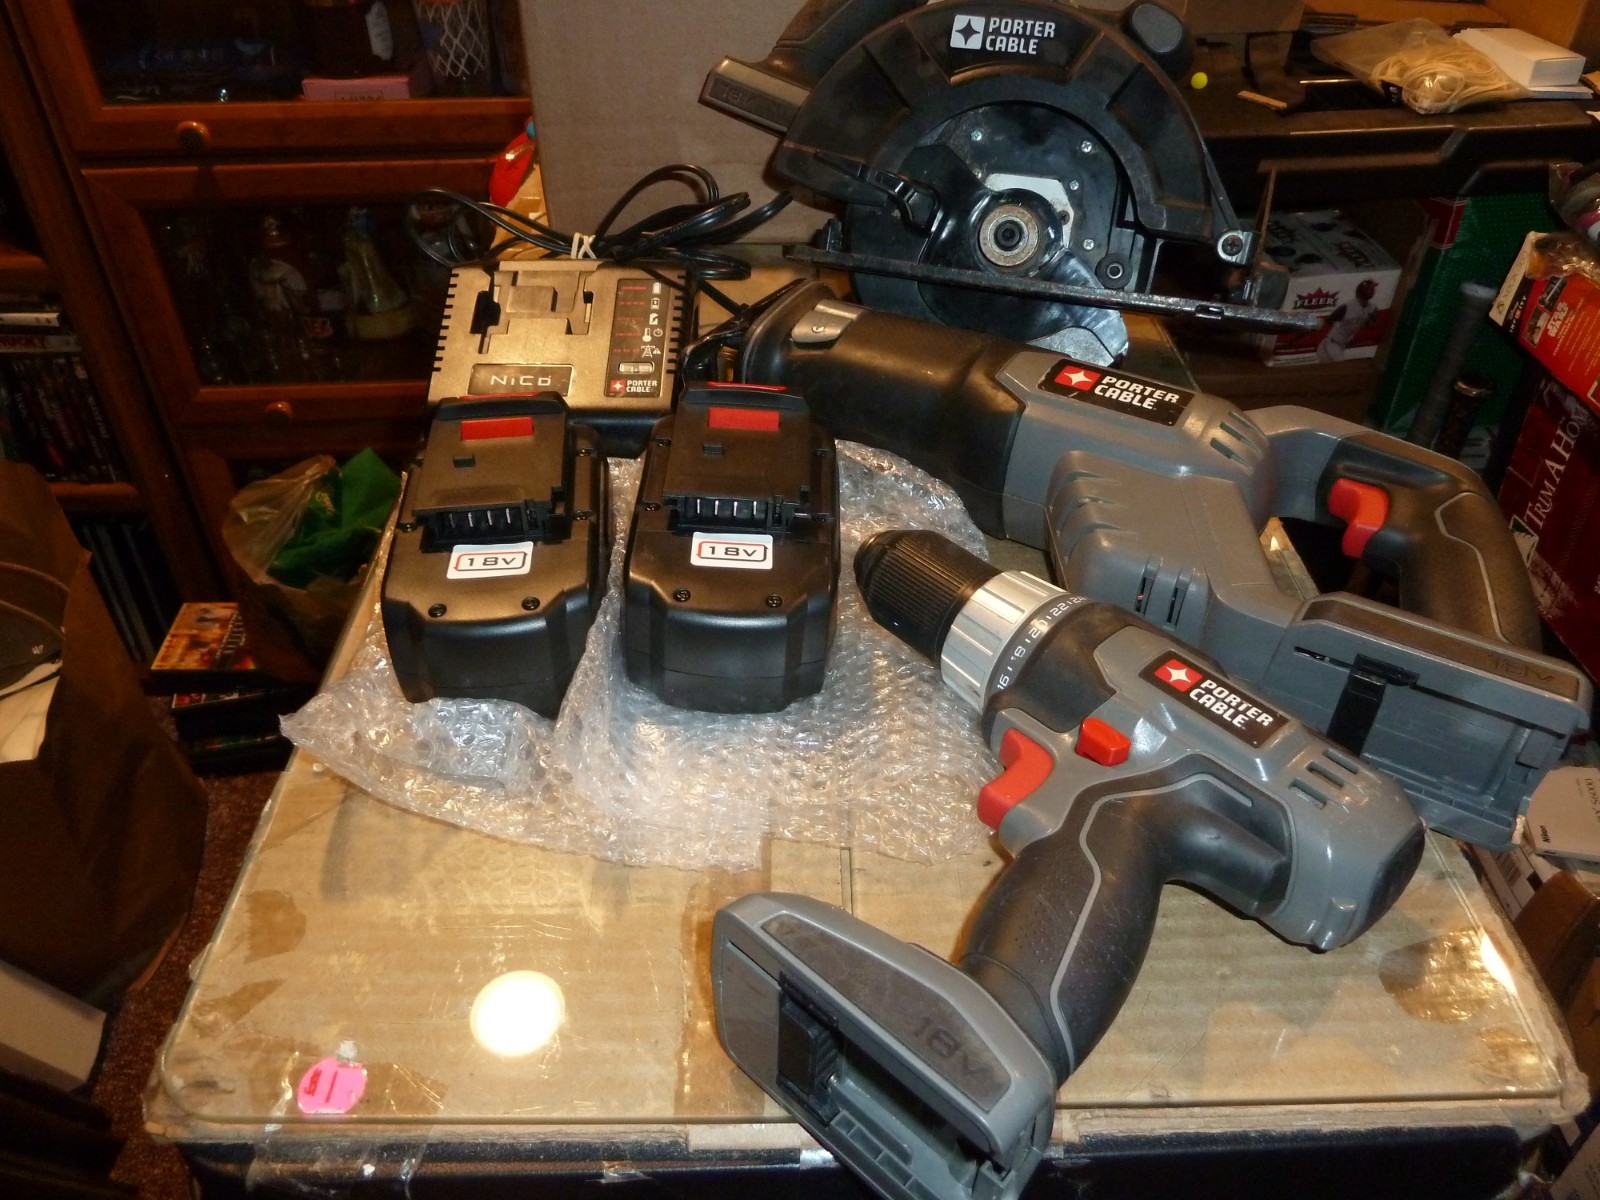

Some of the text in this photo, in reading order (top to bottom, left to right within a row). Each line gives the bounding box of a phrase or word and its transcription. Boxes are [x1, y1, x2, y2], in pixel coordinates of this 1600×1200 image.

[988, 17, 1056, 38] PORTER
[985, 35, 1039, 55] CABLE
[1295, 296, 1336, 307] FLEER
[626, 379, 658, 387] PORTER
[1101, 375, 1180, 404] PORTER
[1094, 384, 1158, 410] CABLE
[708, 545, 757, 558] 18V
[467, 556, 517, 568] 18V
[997, 673, 1010, 690] 16
[1010, 645, 1026, 661] 18
[1028, 619, 1049, 639] 20
[1049, 602, 1070, 617] 22
[1189, 688, 1249, 728] CABLE
[1199, 679, 1274, 727] PORTER
[1539, 825, 1551, 844] Nikon
